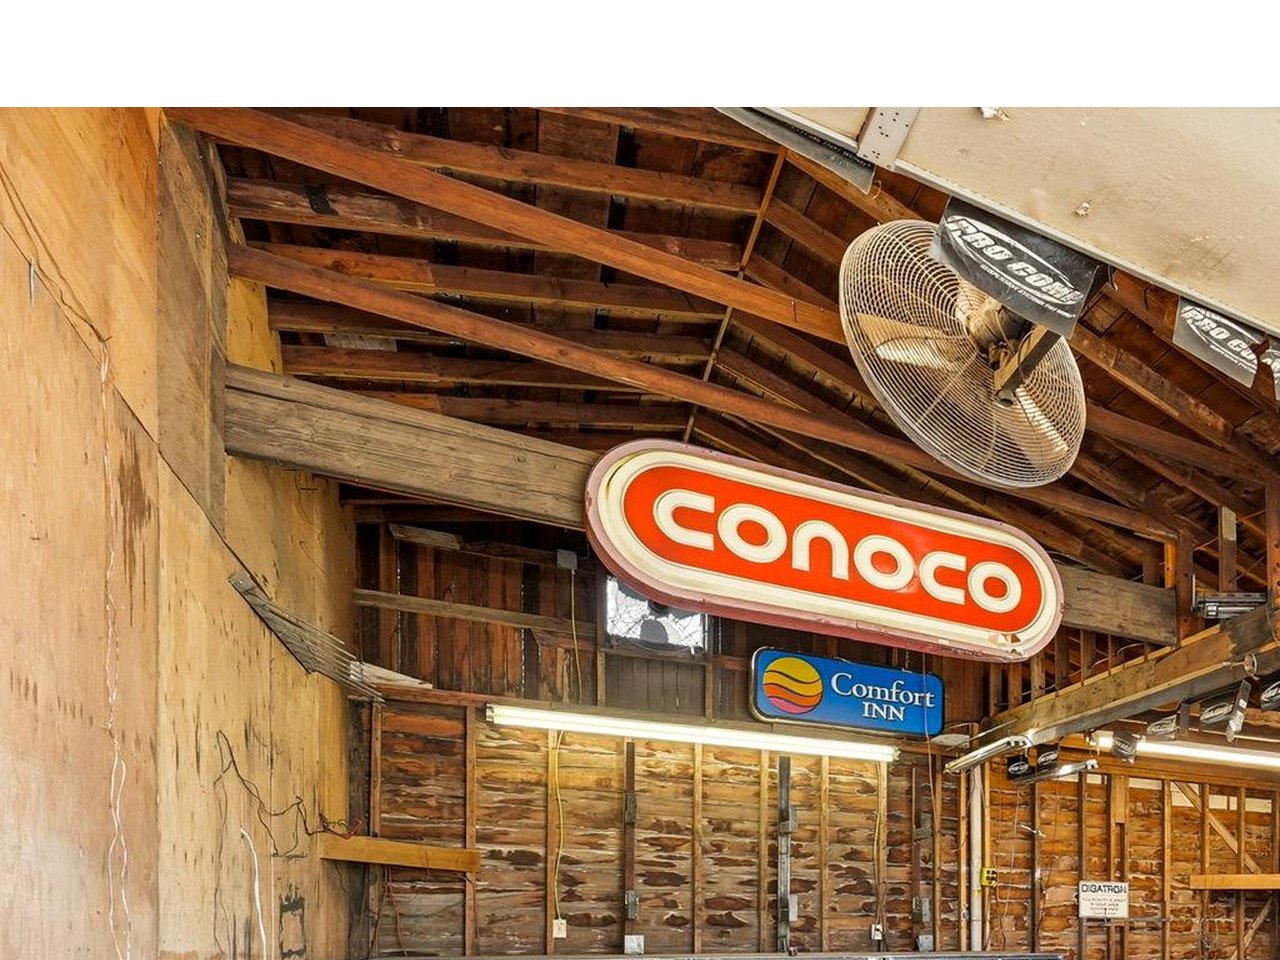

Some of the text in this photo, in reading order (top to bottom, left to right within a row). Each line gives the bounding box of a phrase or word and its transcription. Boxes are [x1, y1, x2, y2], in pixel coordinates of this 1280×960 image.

[945, 218, 1085, 302] PRO COMP
[1181, 309, 1231, 341] PRO
[831, 672, 936, 708] Comfort
[862, 701, 906, 722] INN
